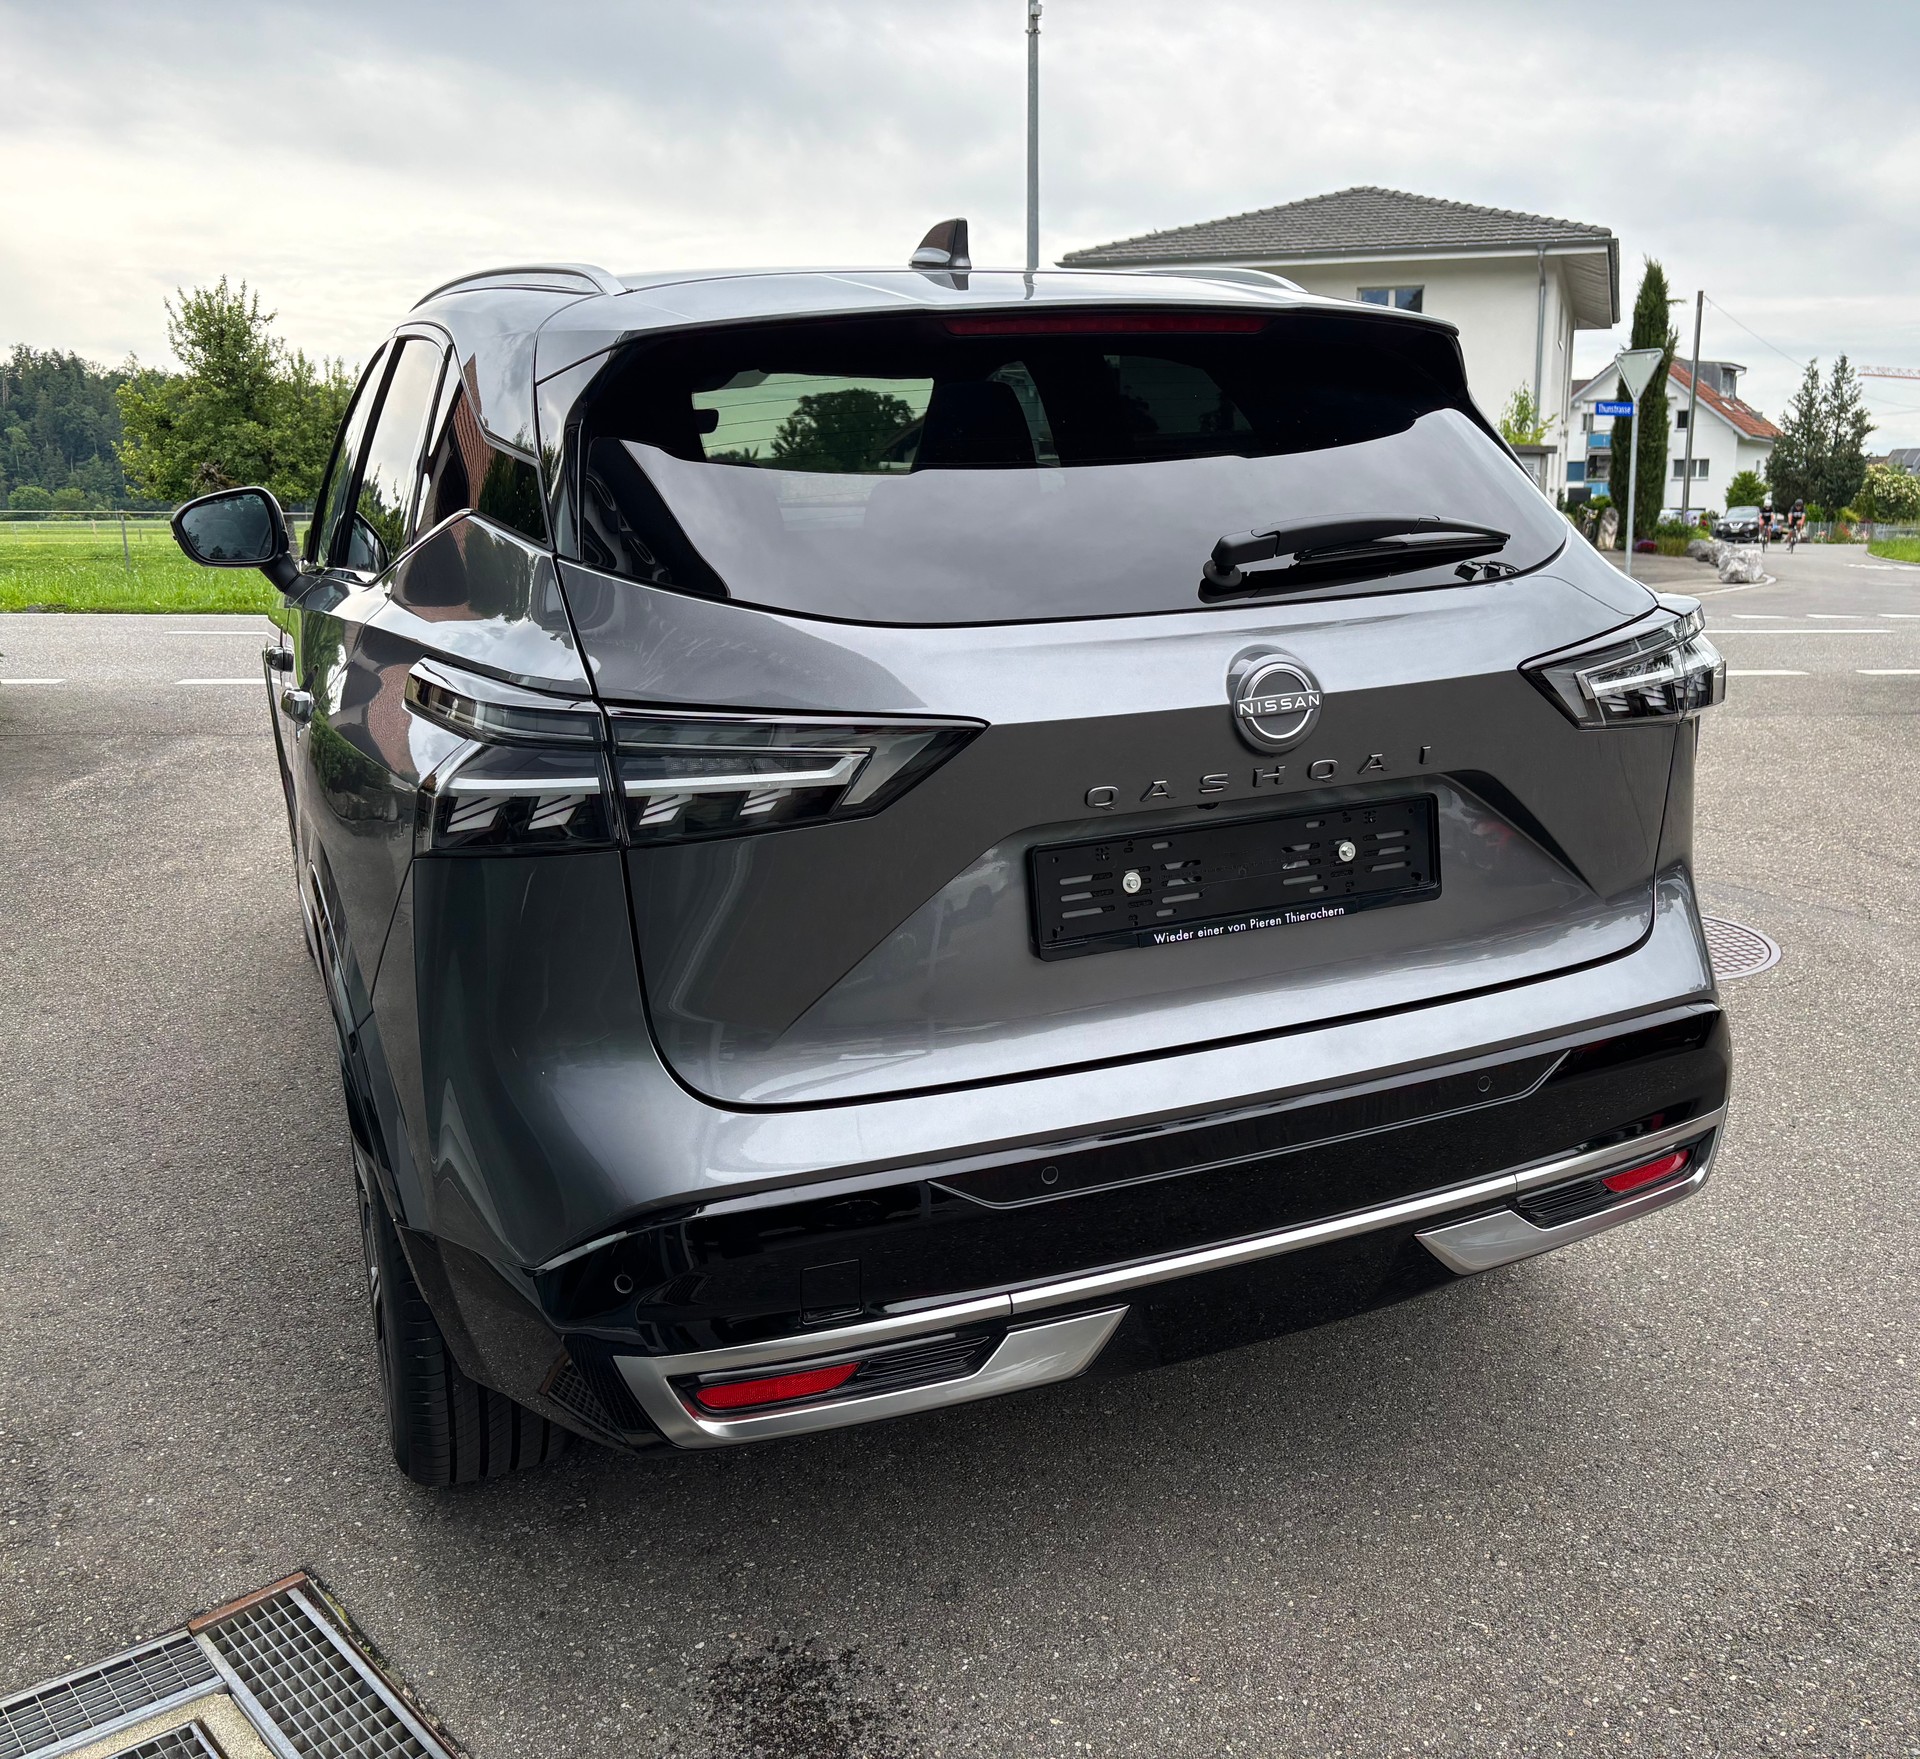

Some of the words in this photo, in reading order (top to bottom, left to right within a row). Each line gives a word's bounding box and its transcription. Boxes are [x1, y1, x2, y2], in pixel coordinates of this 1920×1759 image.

[1598, 403, 1631, 414] Thunstrasse
[1239, 693, 1320, 715] NISSAN
[1085, 745, 1432, 811] QASHQAI
[1154, 930, 1194, 944] Wieder
[1197, 925, 1224, 938] einer
[1227, 923, 1246, 932] von
[1250, 917, 1282, 929] Pieren
[1284, 906, 1345, 923] Thierachern
